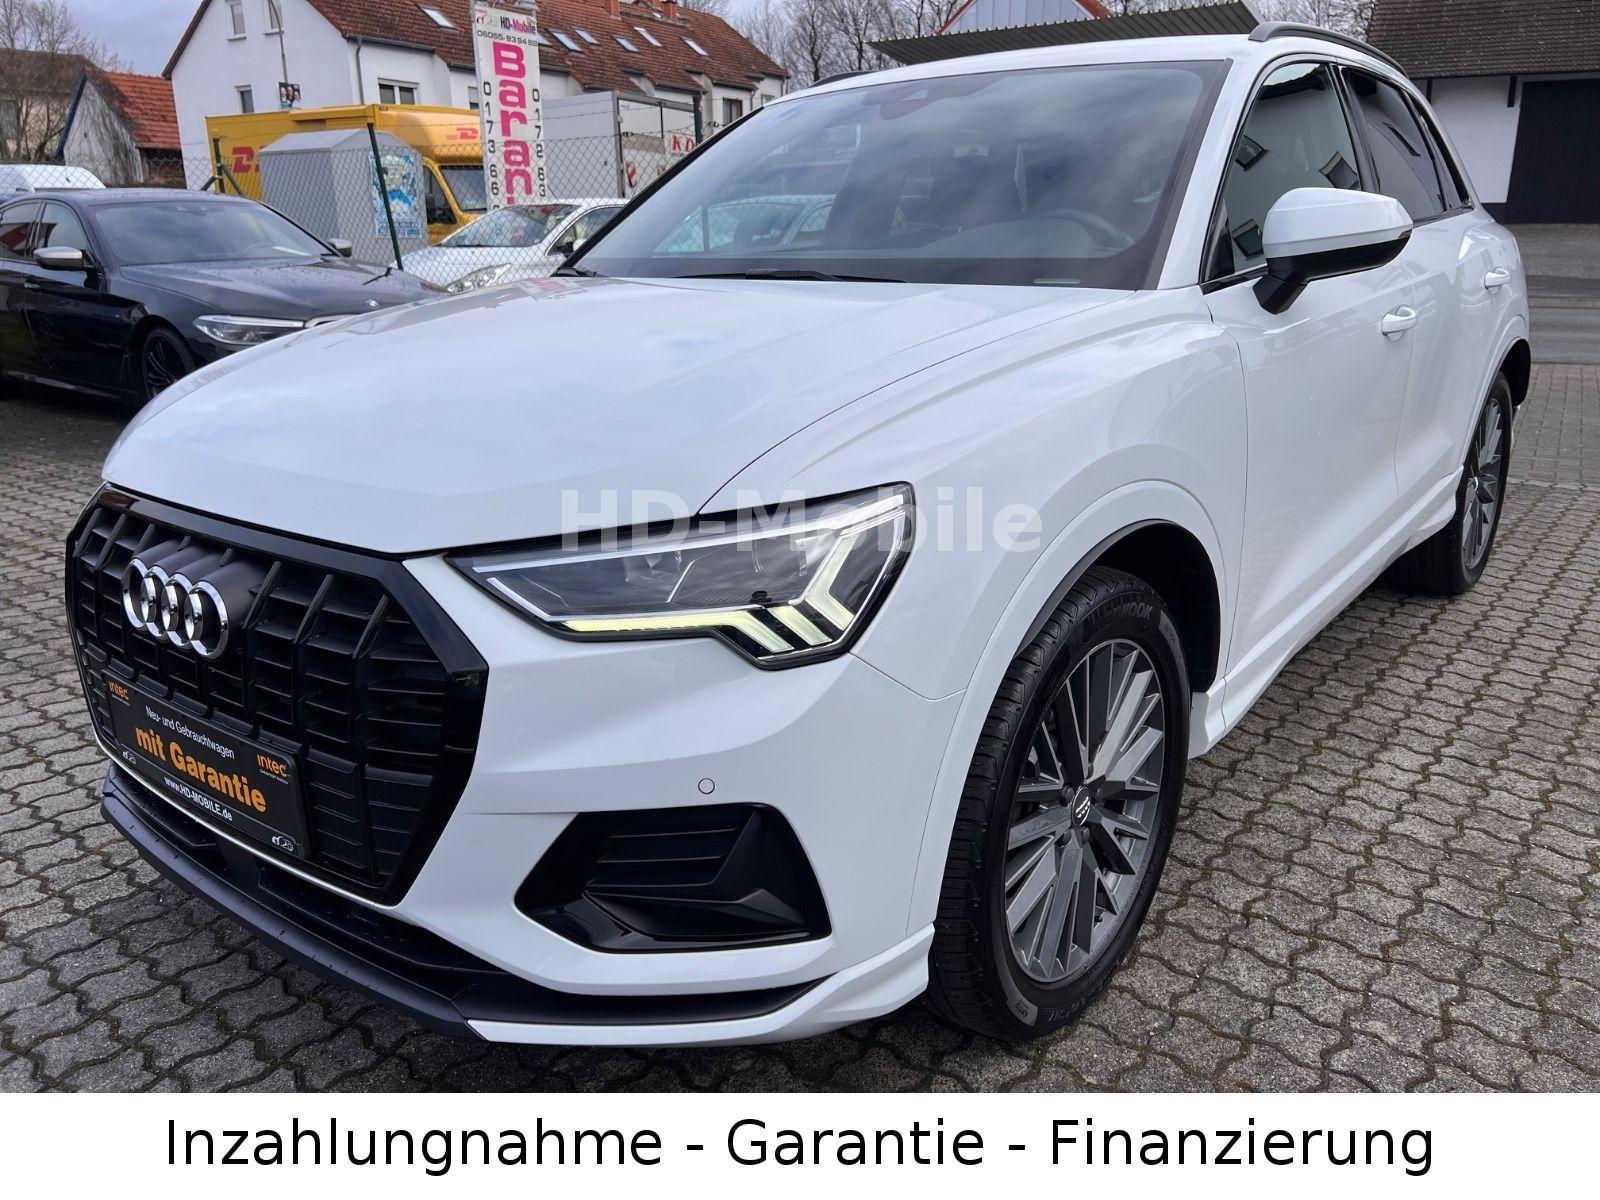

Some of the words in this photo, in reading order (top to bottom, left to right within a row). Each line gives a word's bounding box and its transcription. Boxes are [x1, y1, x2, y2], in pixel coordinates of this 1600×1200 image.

[500, 16, 536, 34] HD-Mobile
[145, 705, 161, 722] Neu-
[162, 716, 176, 730] und
[175, 721, 235, 760] Gebrauchtwagen
[135, 726, 167, 761] mit
[169, 741, 267, 813] Garantie
[164, 776, 233, 821] www.HD-MOBILE.de
